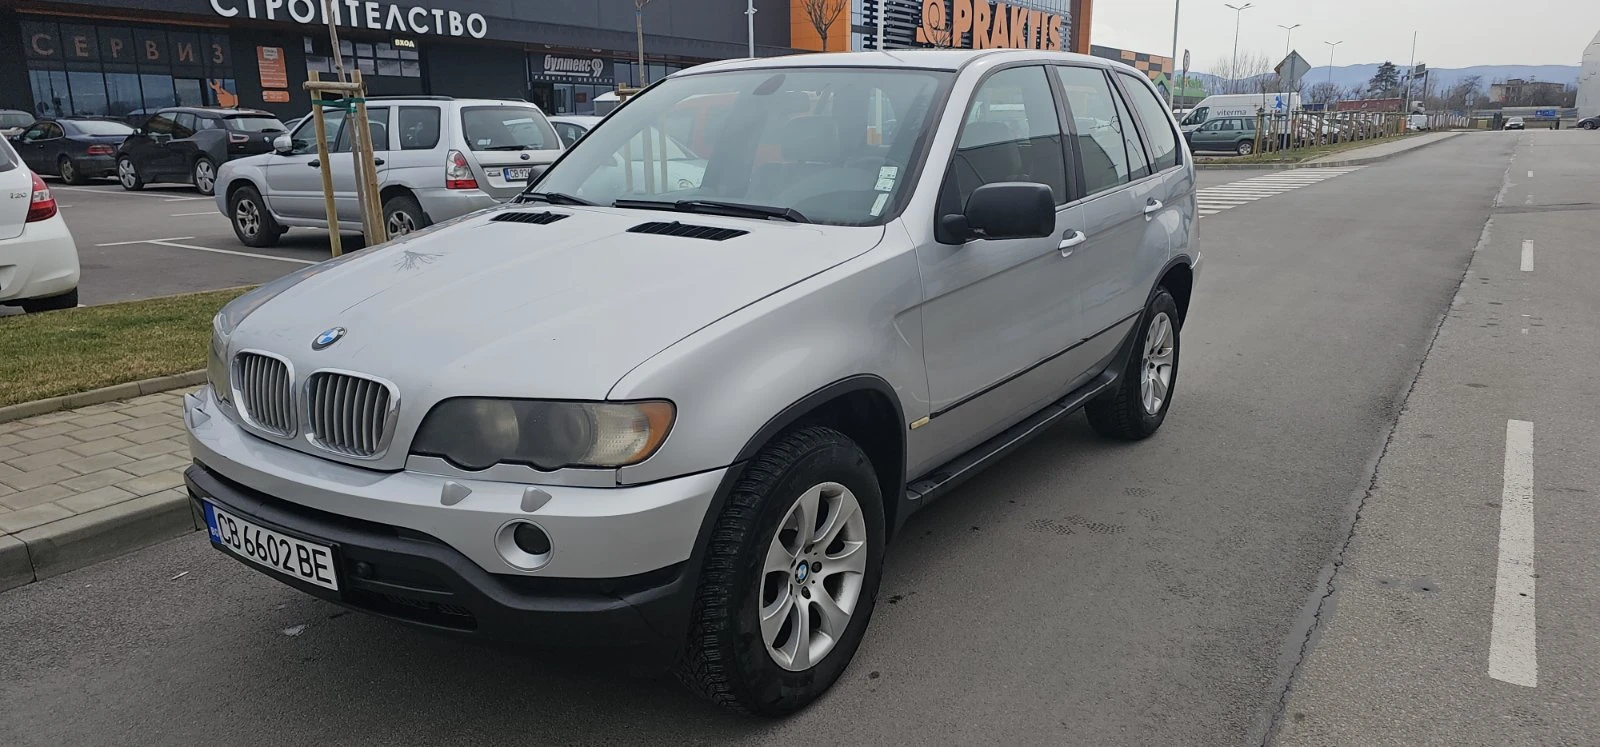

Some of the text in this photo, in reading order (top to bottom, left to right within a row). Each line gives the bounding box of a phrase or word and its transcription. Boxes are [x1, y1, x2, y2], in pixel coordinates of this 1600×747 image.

[210, 0, 488, 39] СТРОИТЕЛСТВО
[953, 0, 1062, 50] PRAKTIS
[31, 33, 225, 64] СЕРВИЗ
[394, 39, 415, 48] ВХОД
